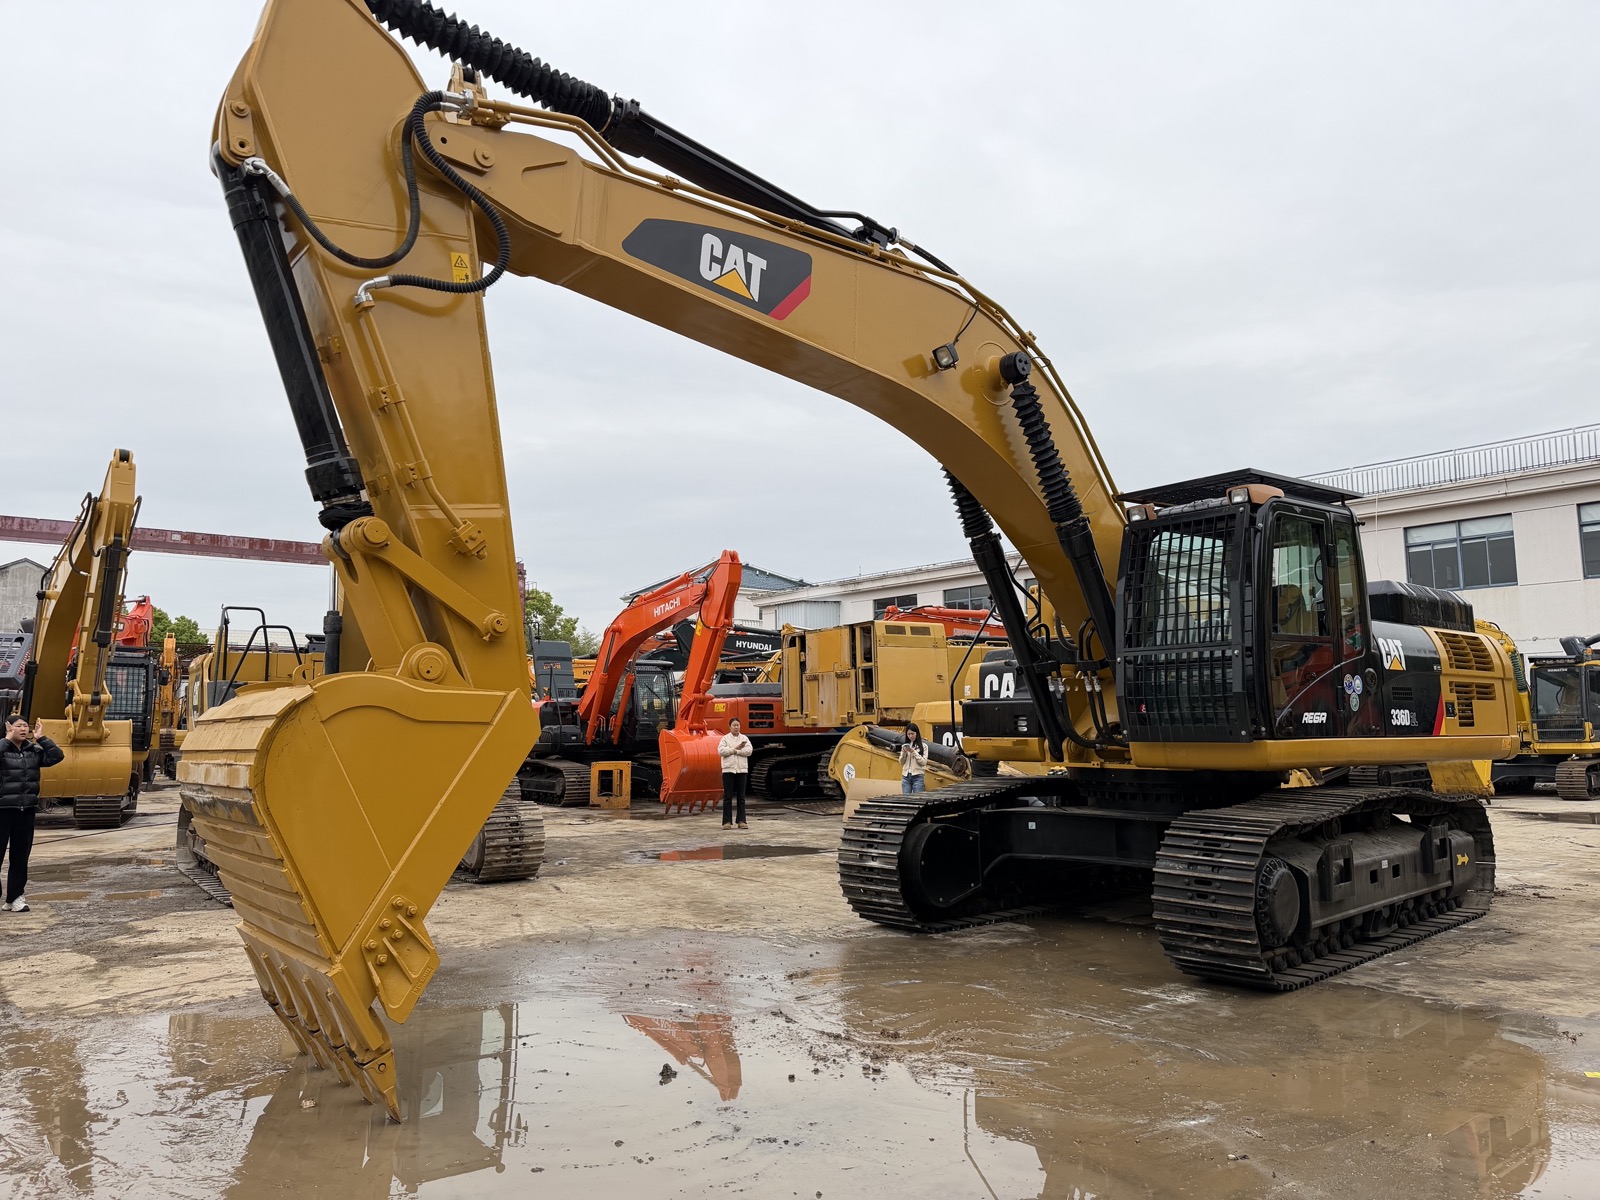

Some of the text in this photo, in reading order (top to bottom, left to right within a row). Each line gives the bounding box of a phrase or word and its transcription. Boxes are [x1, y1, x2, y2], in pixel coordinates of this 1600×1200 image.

[700, 233, 767, 302] CAT
[654, 596, 680, 617] HITACHI
[736, 640, 772, 651] HYUNDAI
[1378, 637, 1406, 670] CAT
